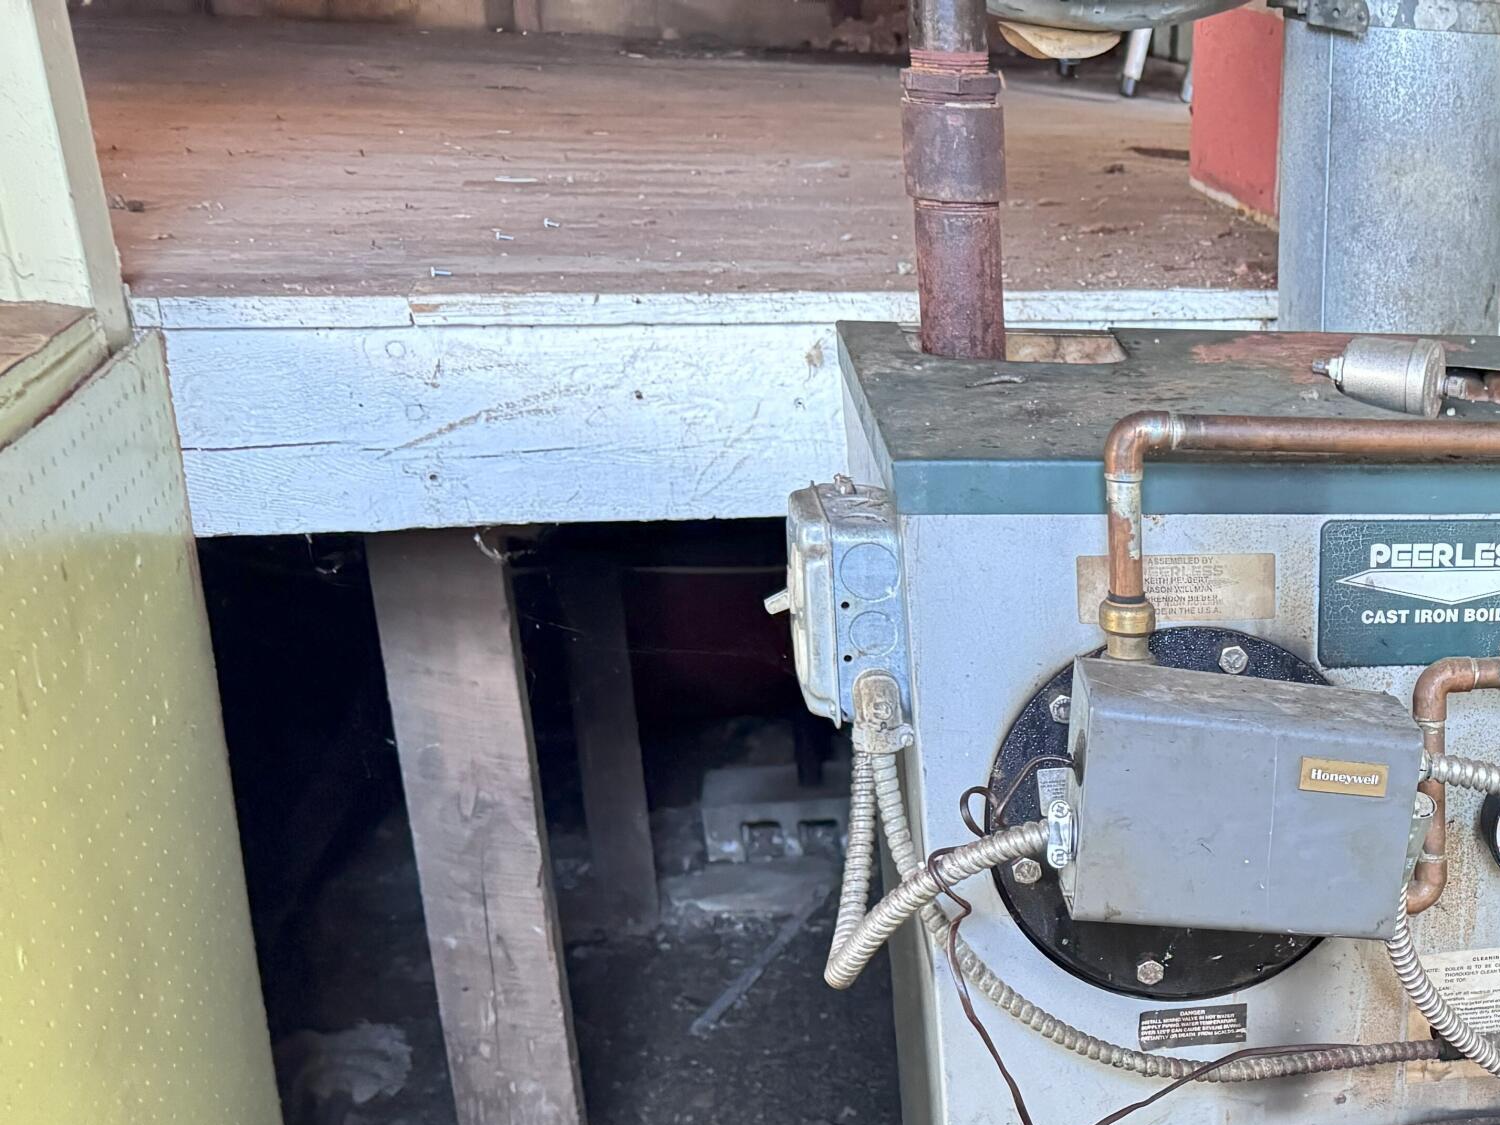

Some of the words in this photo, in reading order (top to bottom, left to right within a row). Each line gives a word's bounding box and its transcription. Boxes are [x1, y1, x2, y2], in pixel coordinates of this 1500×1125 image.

[1148, 556, 1199, 565] ASSEMBLED
[1202, 556, 1213, 564] BY
[1361, 610, 1409, 624] CAST
[1414, 609, 1459, 624] IRON
[1311, 768, 1379, 785] Honeywell
